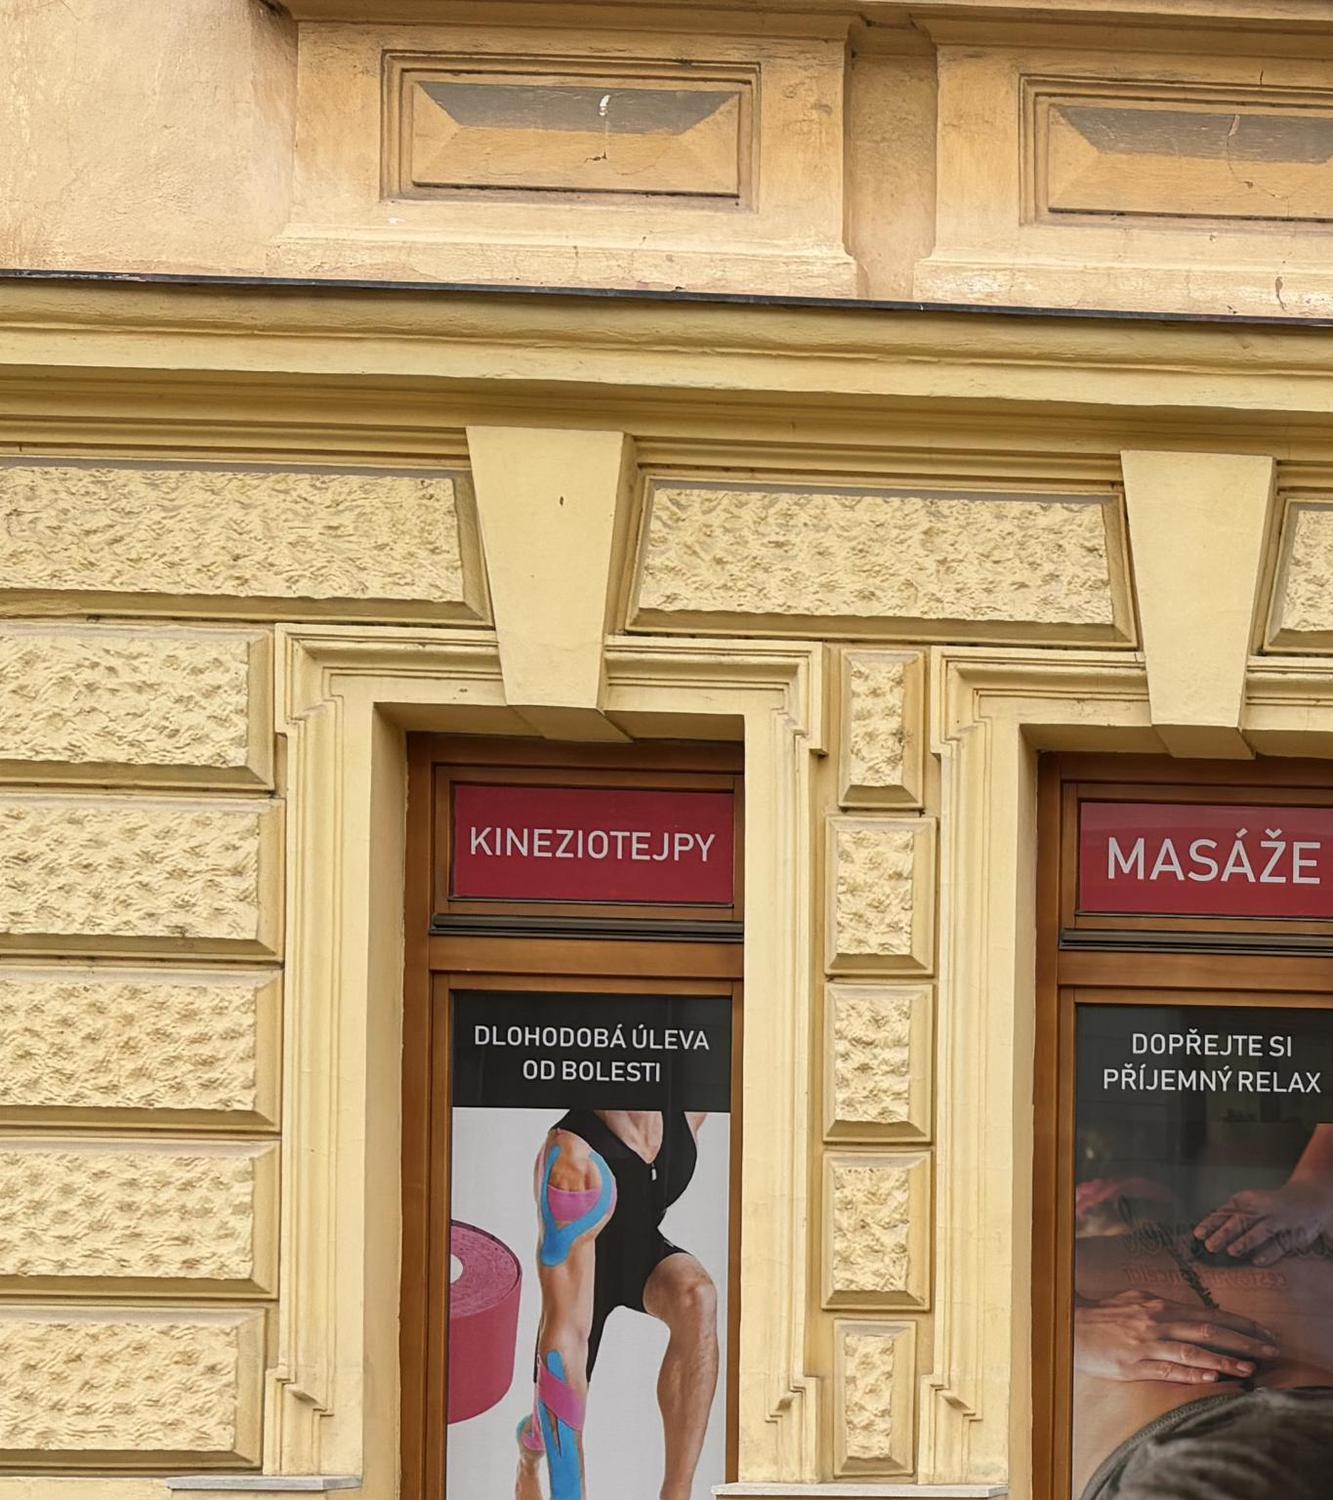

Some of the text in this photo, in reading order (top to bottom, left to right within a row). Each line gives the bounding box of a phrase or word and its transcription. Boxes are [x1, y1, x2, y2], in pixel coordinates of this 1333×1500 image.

[470, 826, 715, 862] KINEZIOTEJPY
[1107, 827, 1321, 884] MASÁŽE
[474, 1023, 710, 1050] DLOHODOBÁ ÚLEVA
[1131, 1028, 1292, 1058] DOPŘEJTE SI
[522, 1059, 661, 1082] OD BOLESTI
[1103, 1062, 1322, 1093] PŘÍJEMNÝ RELAX
